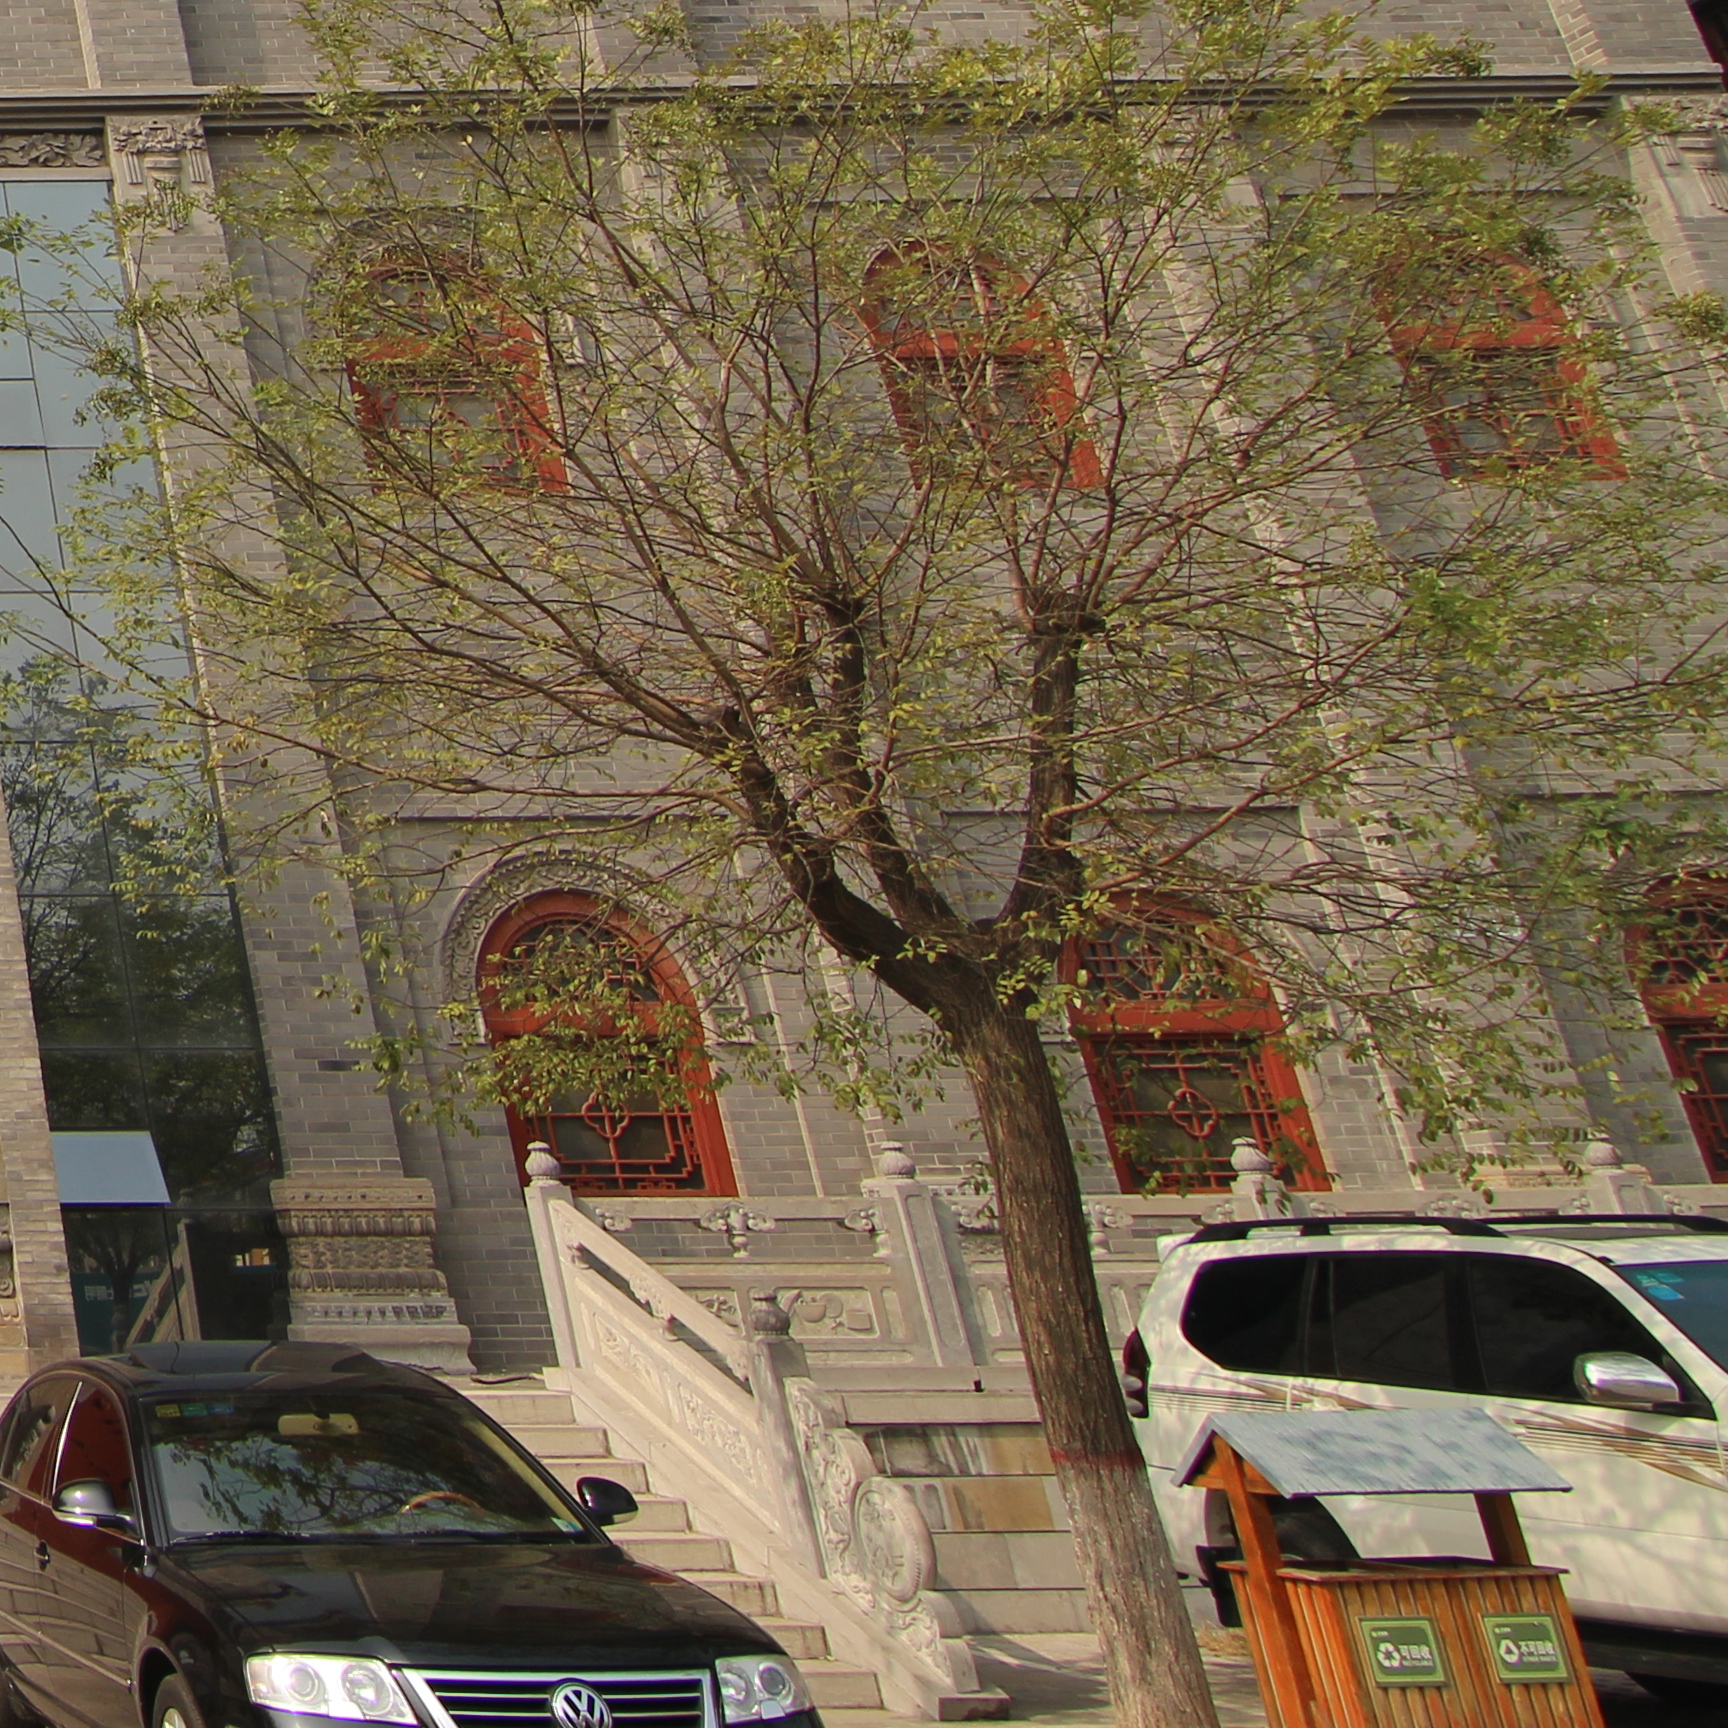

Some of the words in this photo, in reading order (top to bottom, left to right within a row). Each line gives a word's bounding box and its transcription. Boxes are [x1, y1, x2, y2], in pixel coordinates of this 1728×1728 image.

[1397, 1644, 1433, 1660] 可回收
[1517, 1640, 1556, 1656] 不可回收
